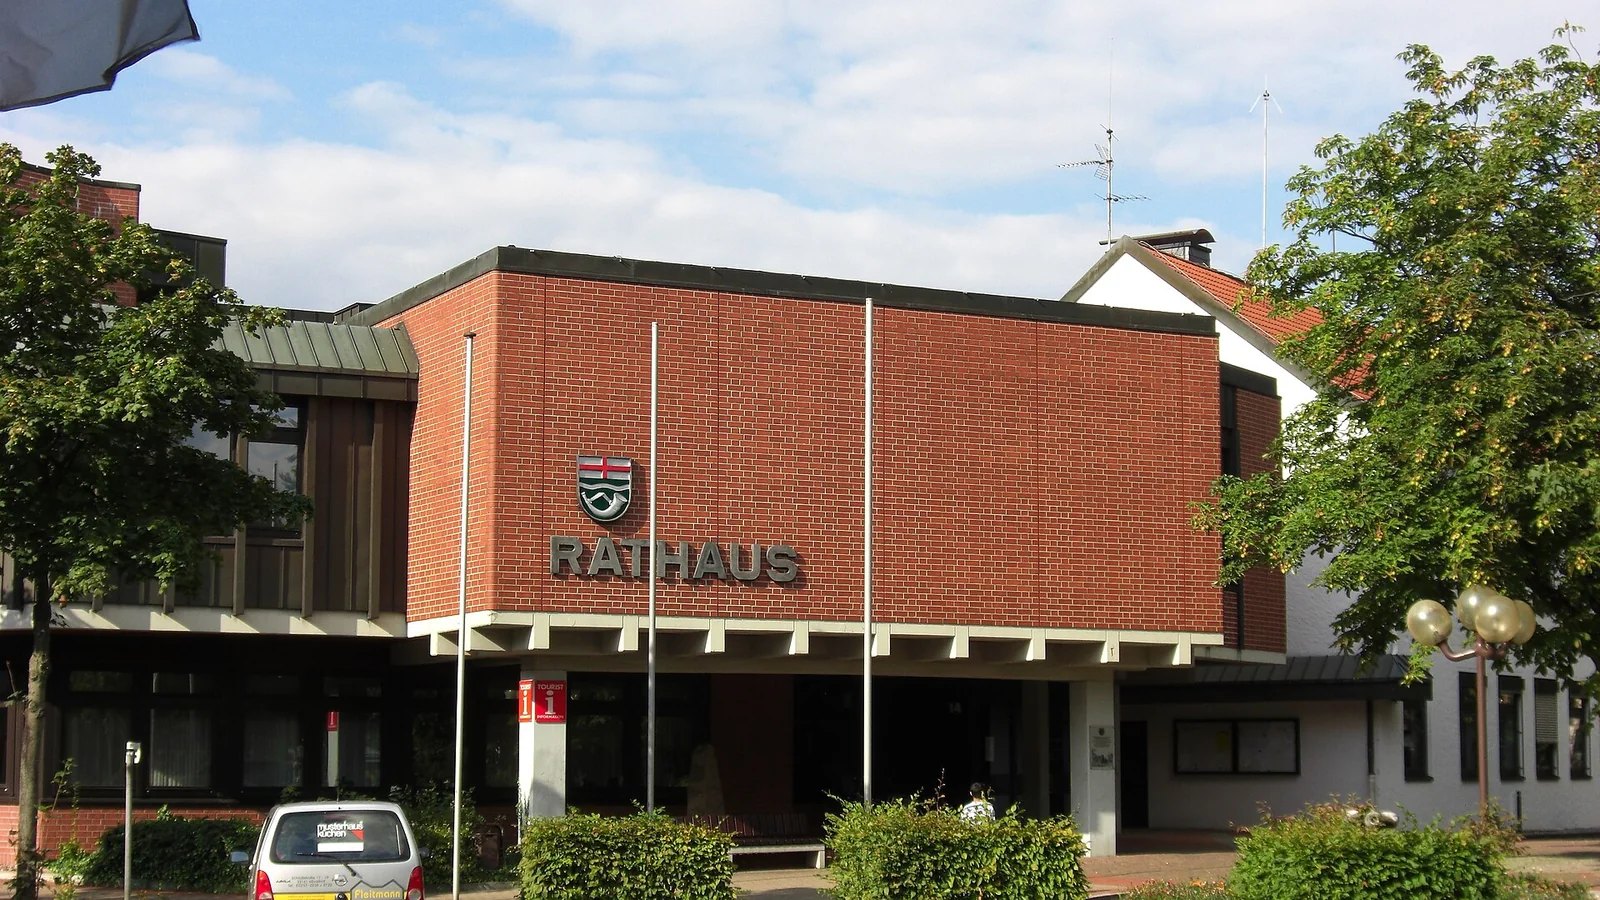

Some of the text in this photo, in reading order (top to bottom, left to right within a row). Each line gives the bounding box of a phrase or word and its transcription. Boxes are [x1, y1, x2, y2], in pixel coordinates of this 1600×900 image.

[549, 535, 798, 583] RATHAUS
[317, 820, 364, 830] musterhaus
[354, 889, 401, 899] Fleitmann
